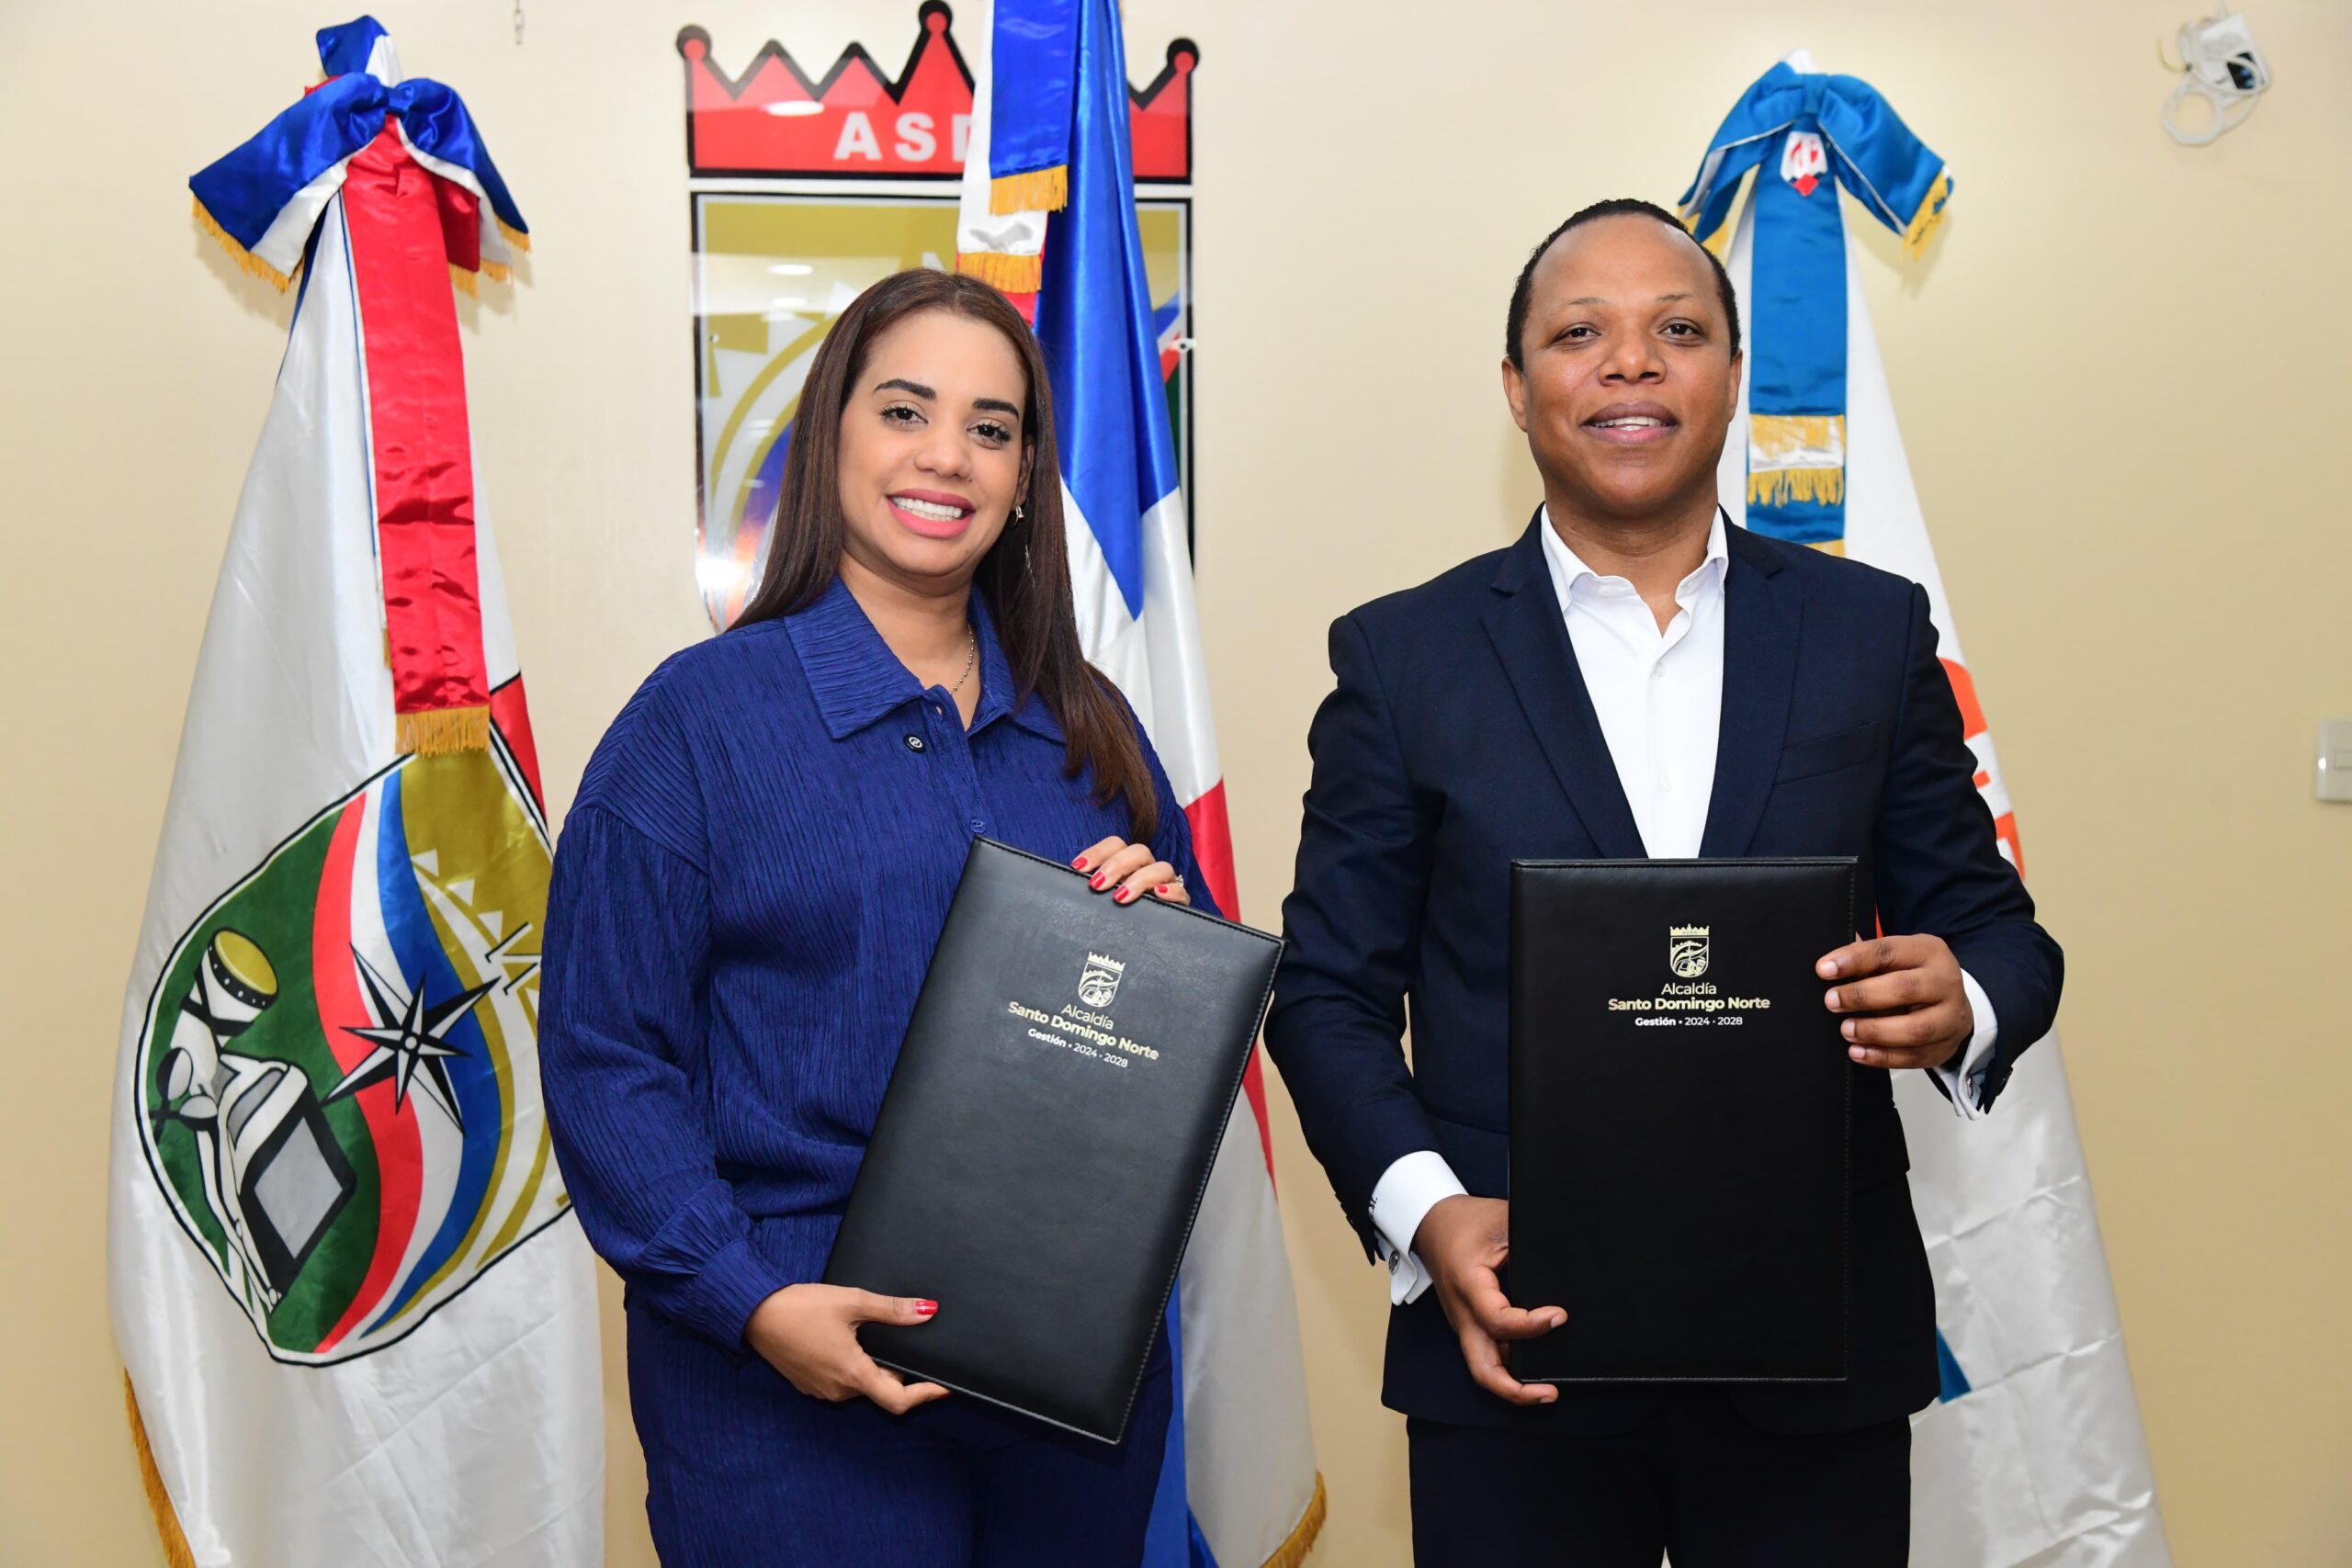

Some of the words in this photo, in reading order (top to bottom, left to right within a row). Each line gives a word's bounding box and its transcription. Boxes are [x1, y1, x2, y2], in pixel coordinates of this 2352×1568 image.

[1661, 982, 1717, 995] Alcaldía
[1608, 998, 1652, 1010] Santo
[1655, 997, 1724, 1011] Domingo
[1728, 997, 1770, 1010] Norte
[1061, 1004, 1114, 1030] Alcaldía
[1634, 1017, 1676, 1026] Gestión
[1684, 1017, 1710, 1026] 2024
[1718, 1017, 1743, 1025] 2028
[1008, 1000, 1049, 1024] Santo
[1051, 1015, 1116, 1046] Domingo
[1119, 1037, 1159, 1059] Norte
[1028, 1028, 1067, 1048] Gestión
[1073, 1043, 1097, 1058] 2024
[1103, 1054, 1128, 1067] 2028
